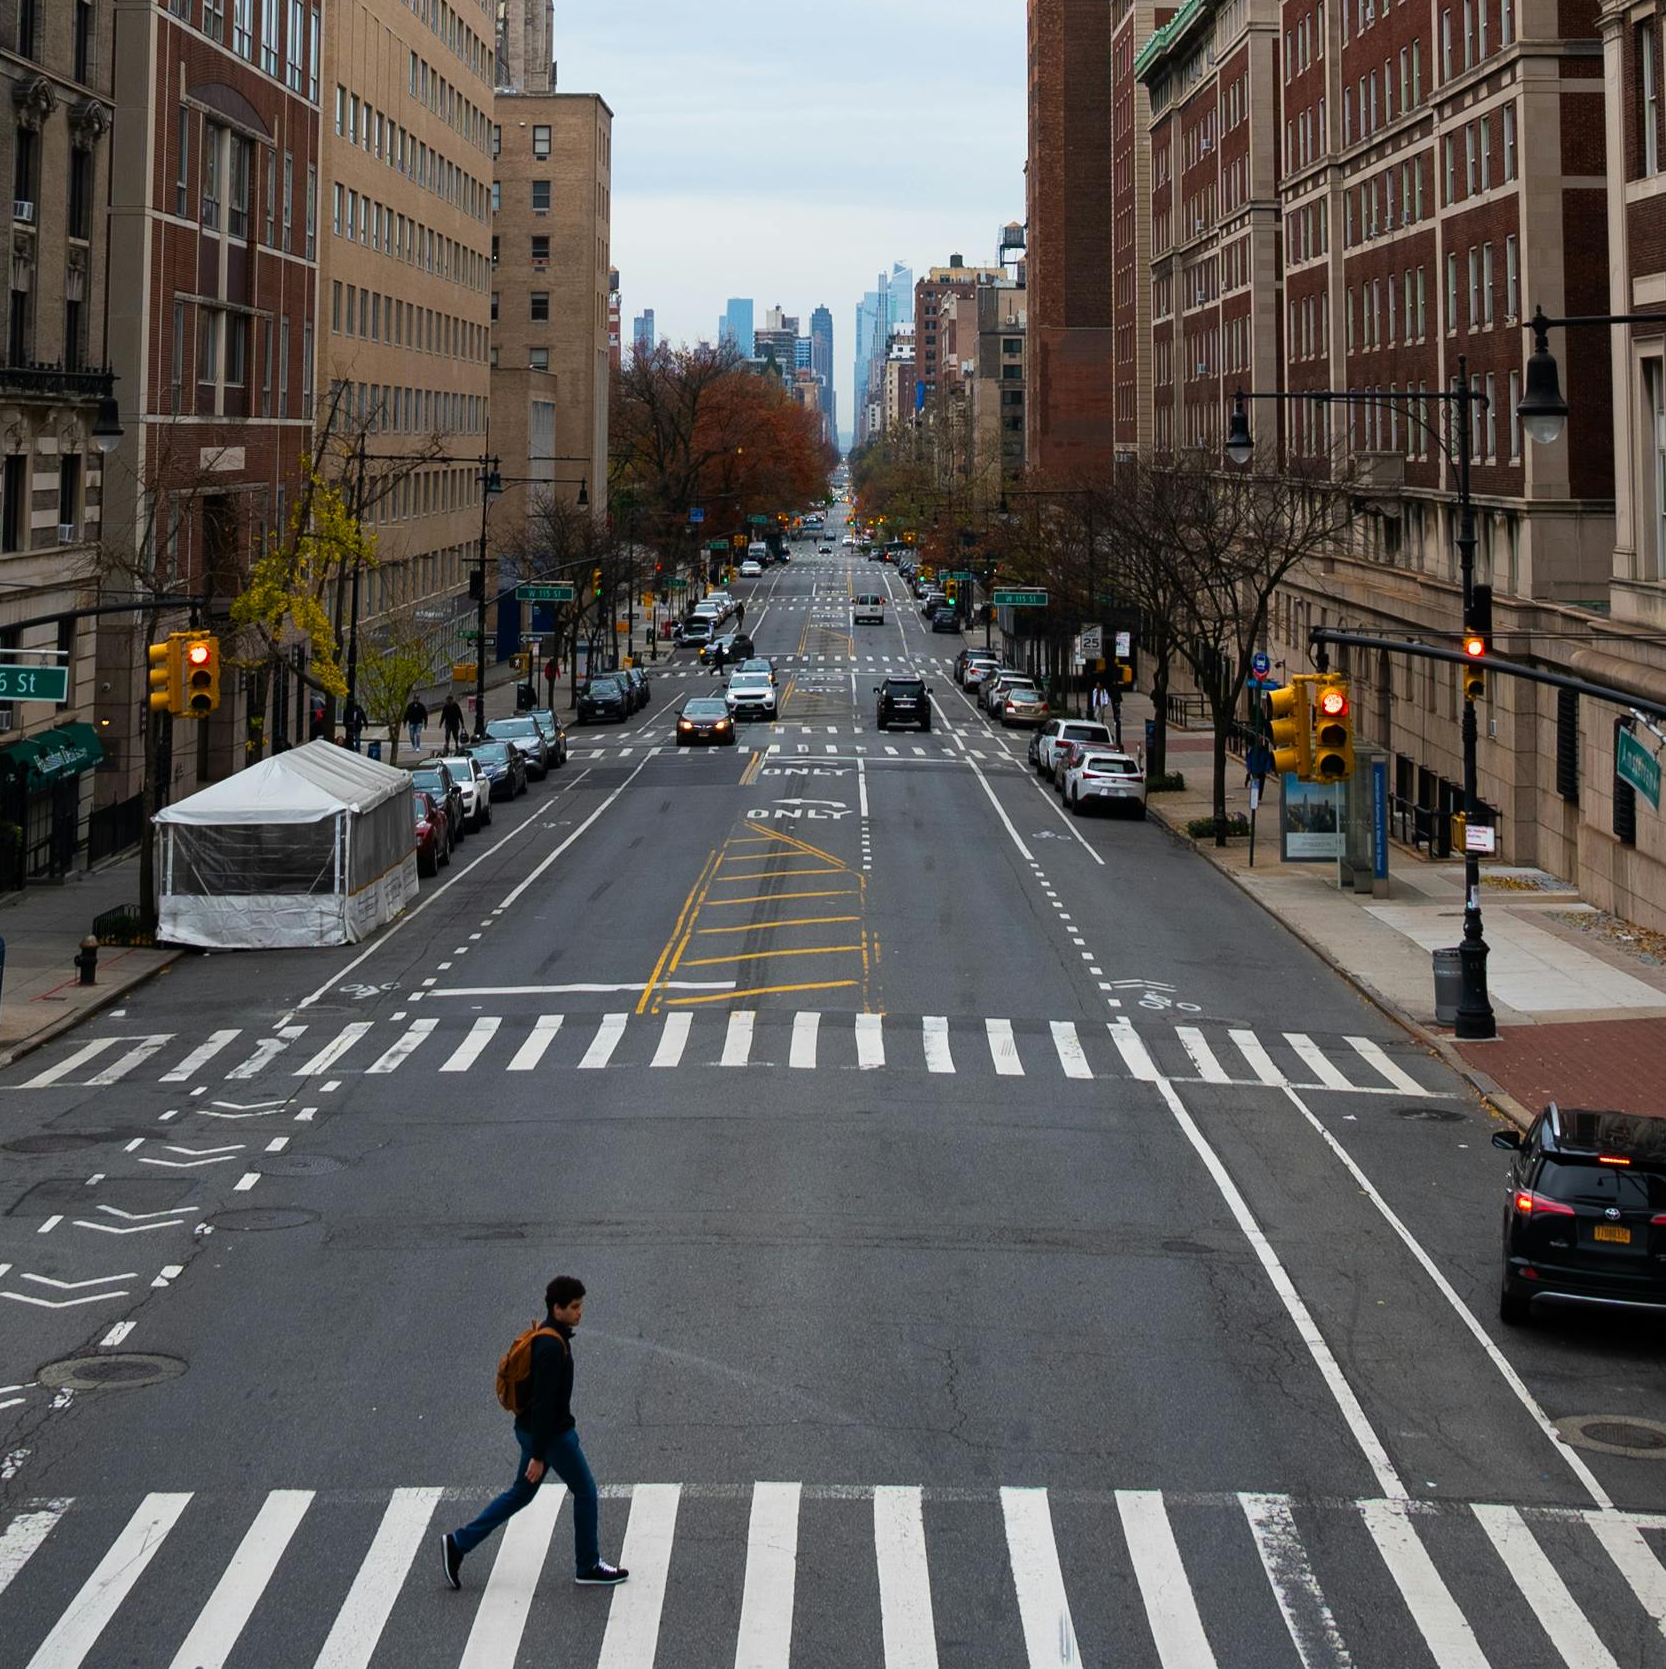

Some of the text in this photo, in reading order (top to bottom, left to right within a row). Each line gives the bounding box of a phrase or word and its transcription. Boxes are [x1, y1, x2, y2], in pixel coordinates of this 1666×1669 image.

[1083, 638, 1100, 648] 25
[17, 674, 36, 693] St
[761, 768, 853, 776] ONLY
[746, 809, 854, 819] ONLY
